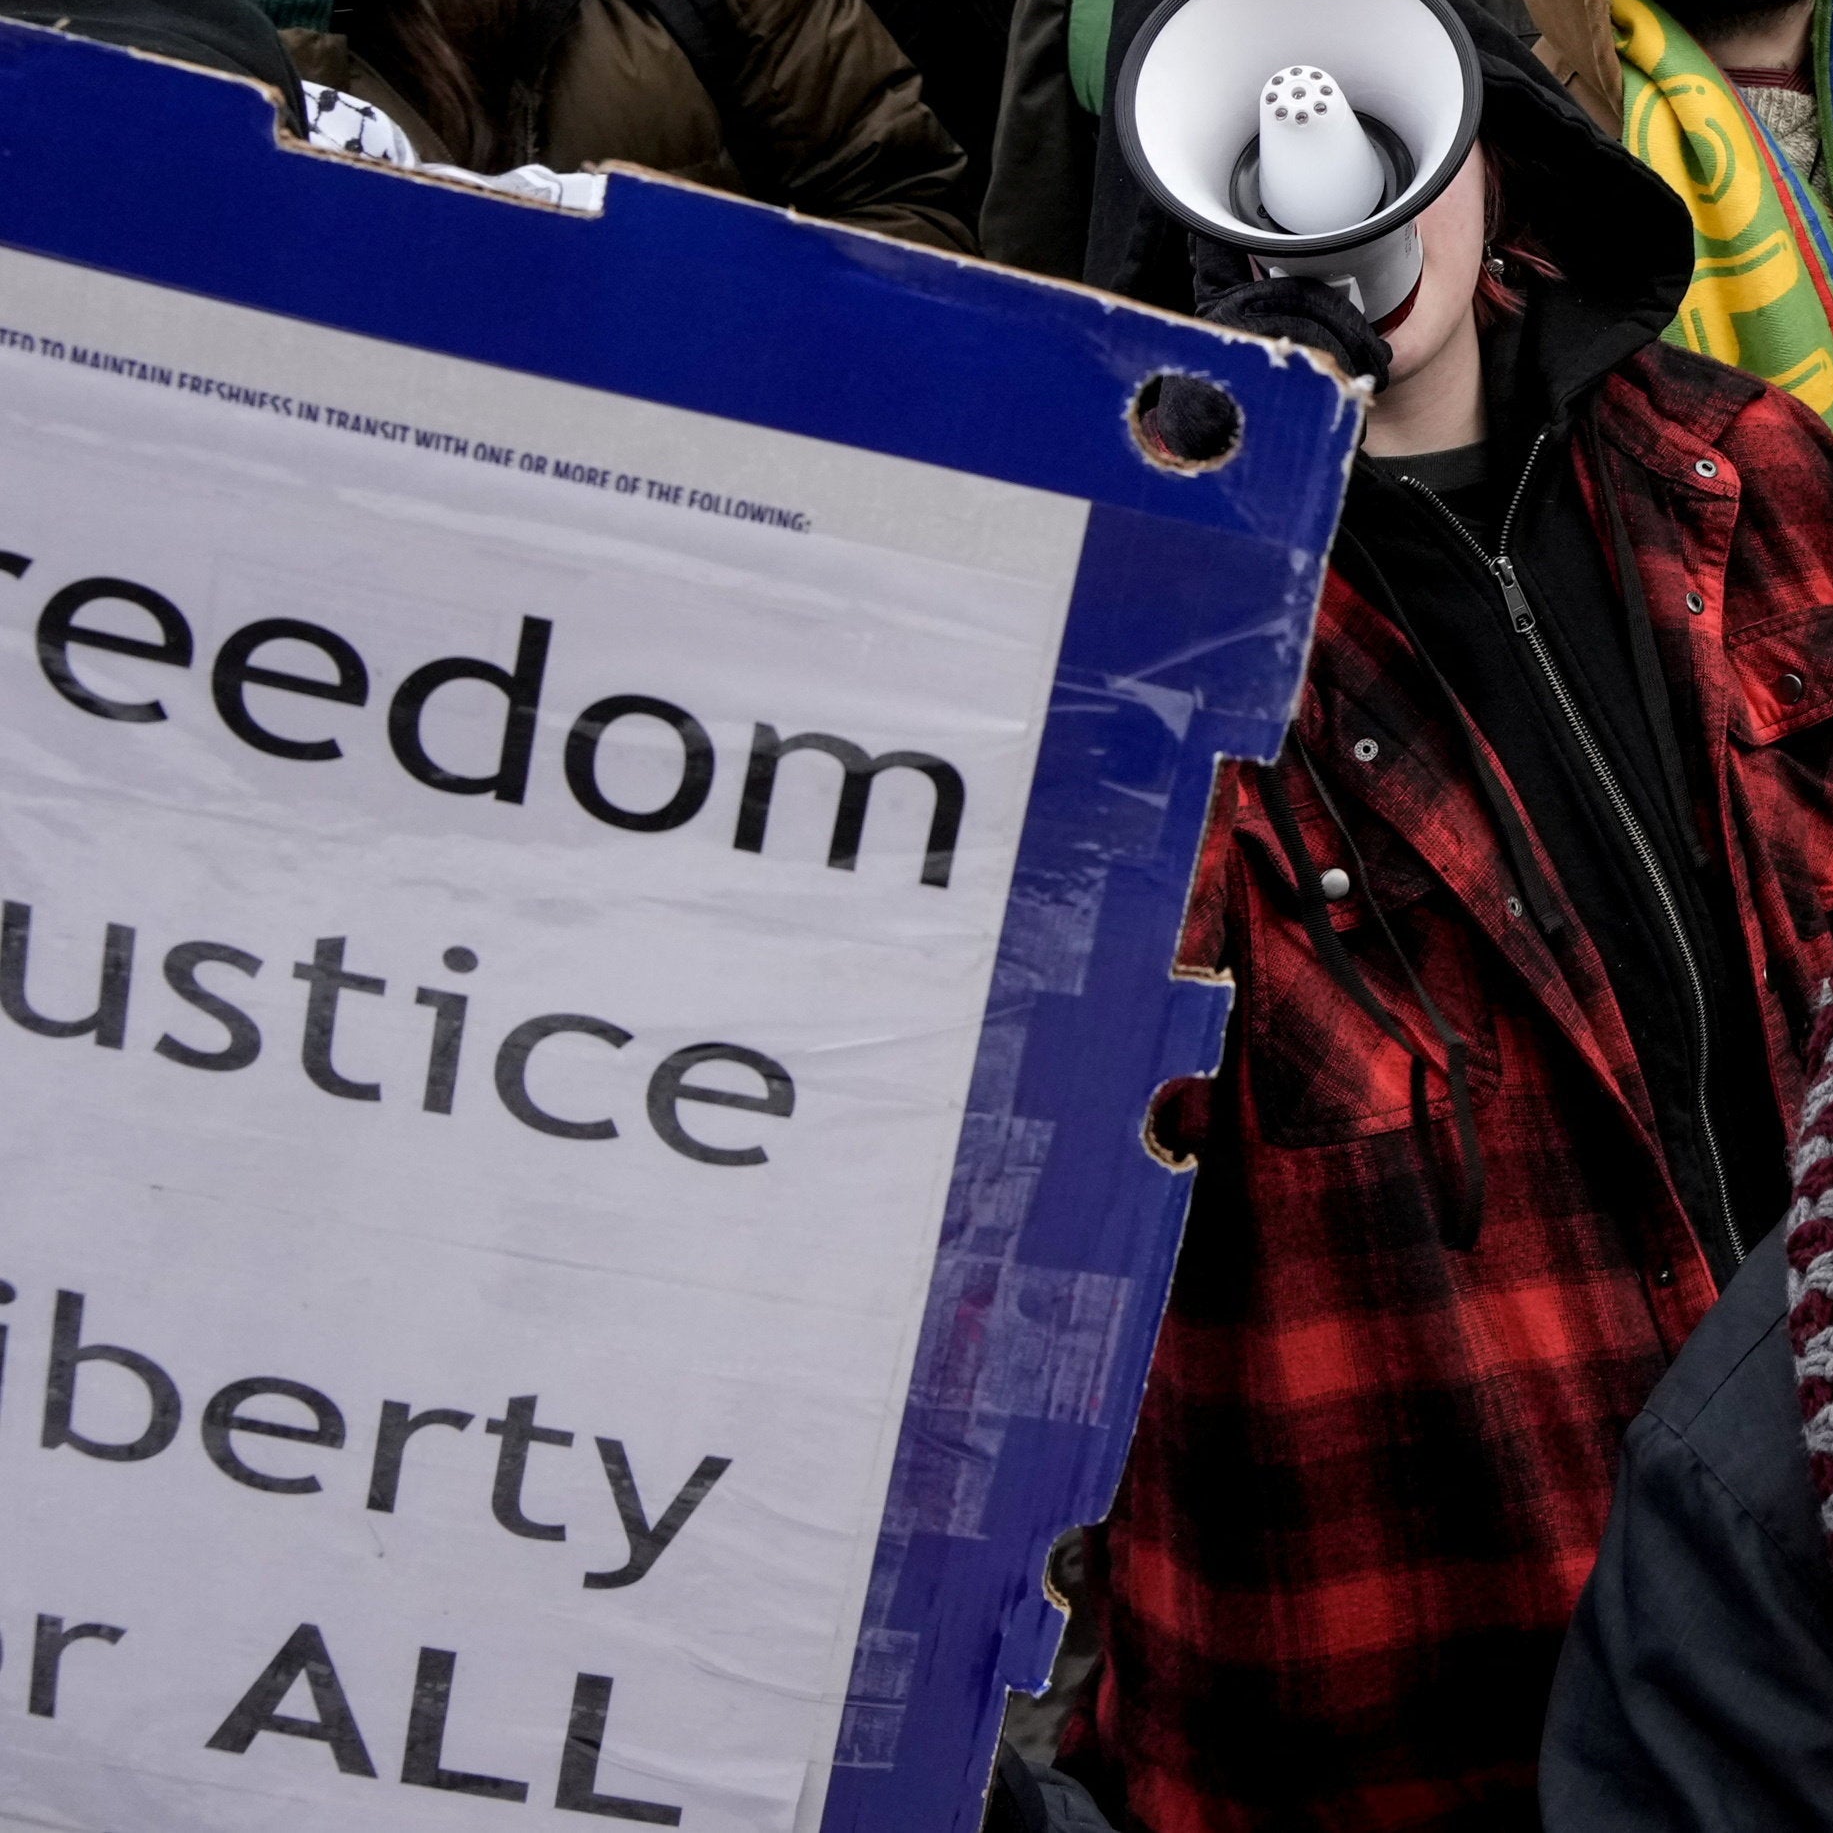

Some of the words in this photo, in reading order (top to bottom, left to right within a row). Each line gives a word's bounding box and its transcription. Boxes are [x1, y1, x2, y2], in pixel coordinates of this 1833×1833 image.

[39, 338, 65, 360] TO
[70, 346, 172, 387] MAINTAIN
[178, 372, 293, 417] FRESHNESS
[298, 402, 319, 423] IN
[324, 407, 411, 444] TRANSIT
[415, 428, 470, 457] WITH
[474, 442, 513, 467] ONE
[519, 452, 548, 475] OR
[552, 460, 611, 489] MORE
[615, 475, 641, 495] OF
[647, 480, 683, 505] THE
[688, 490, 812, 533] FOLLOWING:
[0, 1609, 126, 1719] r
[205, 1620, 682, 1829] ALL
